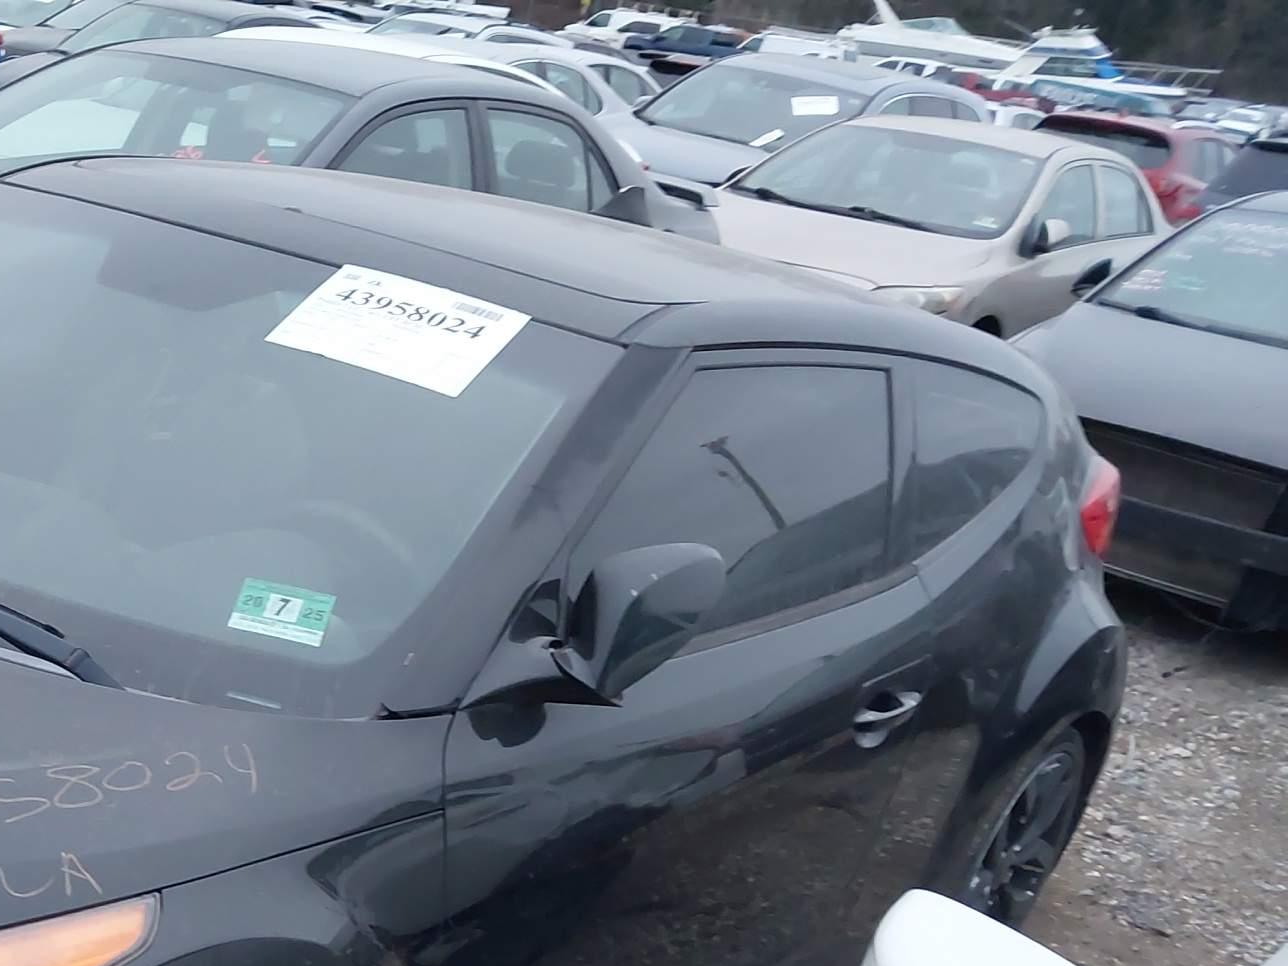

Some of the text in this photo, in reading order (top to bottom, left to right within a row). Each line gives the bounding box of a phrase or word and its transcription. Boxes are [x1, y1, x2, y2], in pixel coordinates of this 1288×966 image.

[335, 287, 487, 340] 43958024
[274, 598, 292, 616] 7
[301, 607, 327, 622] 25
